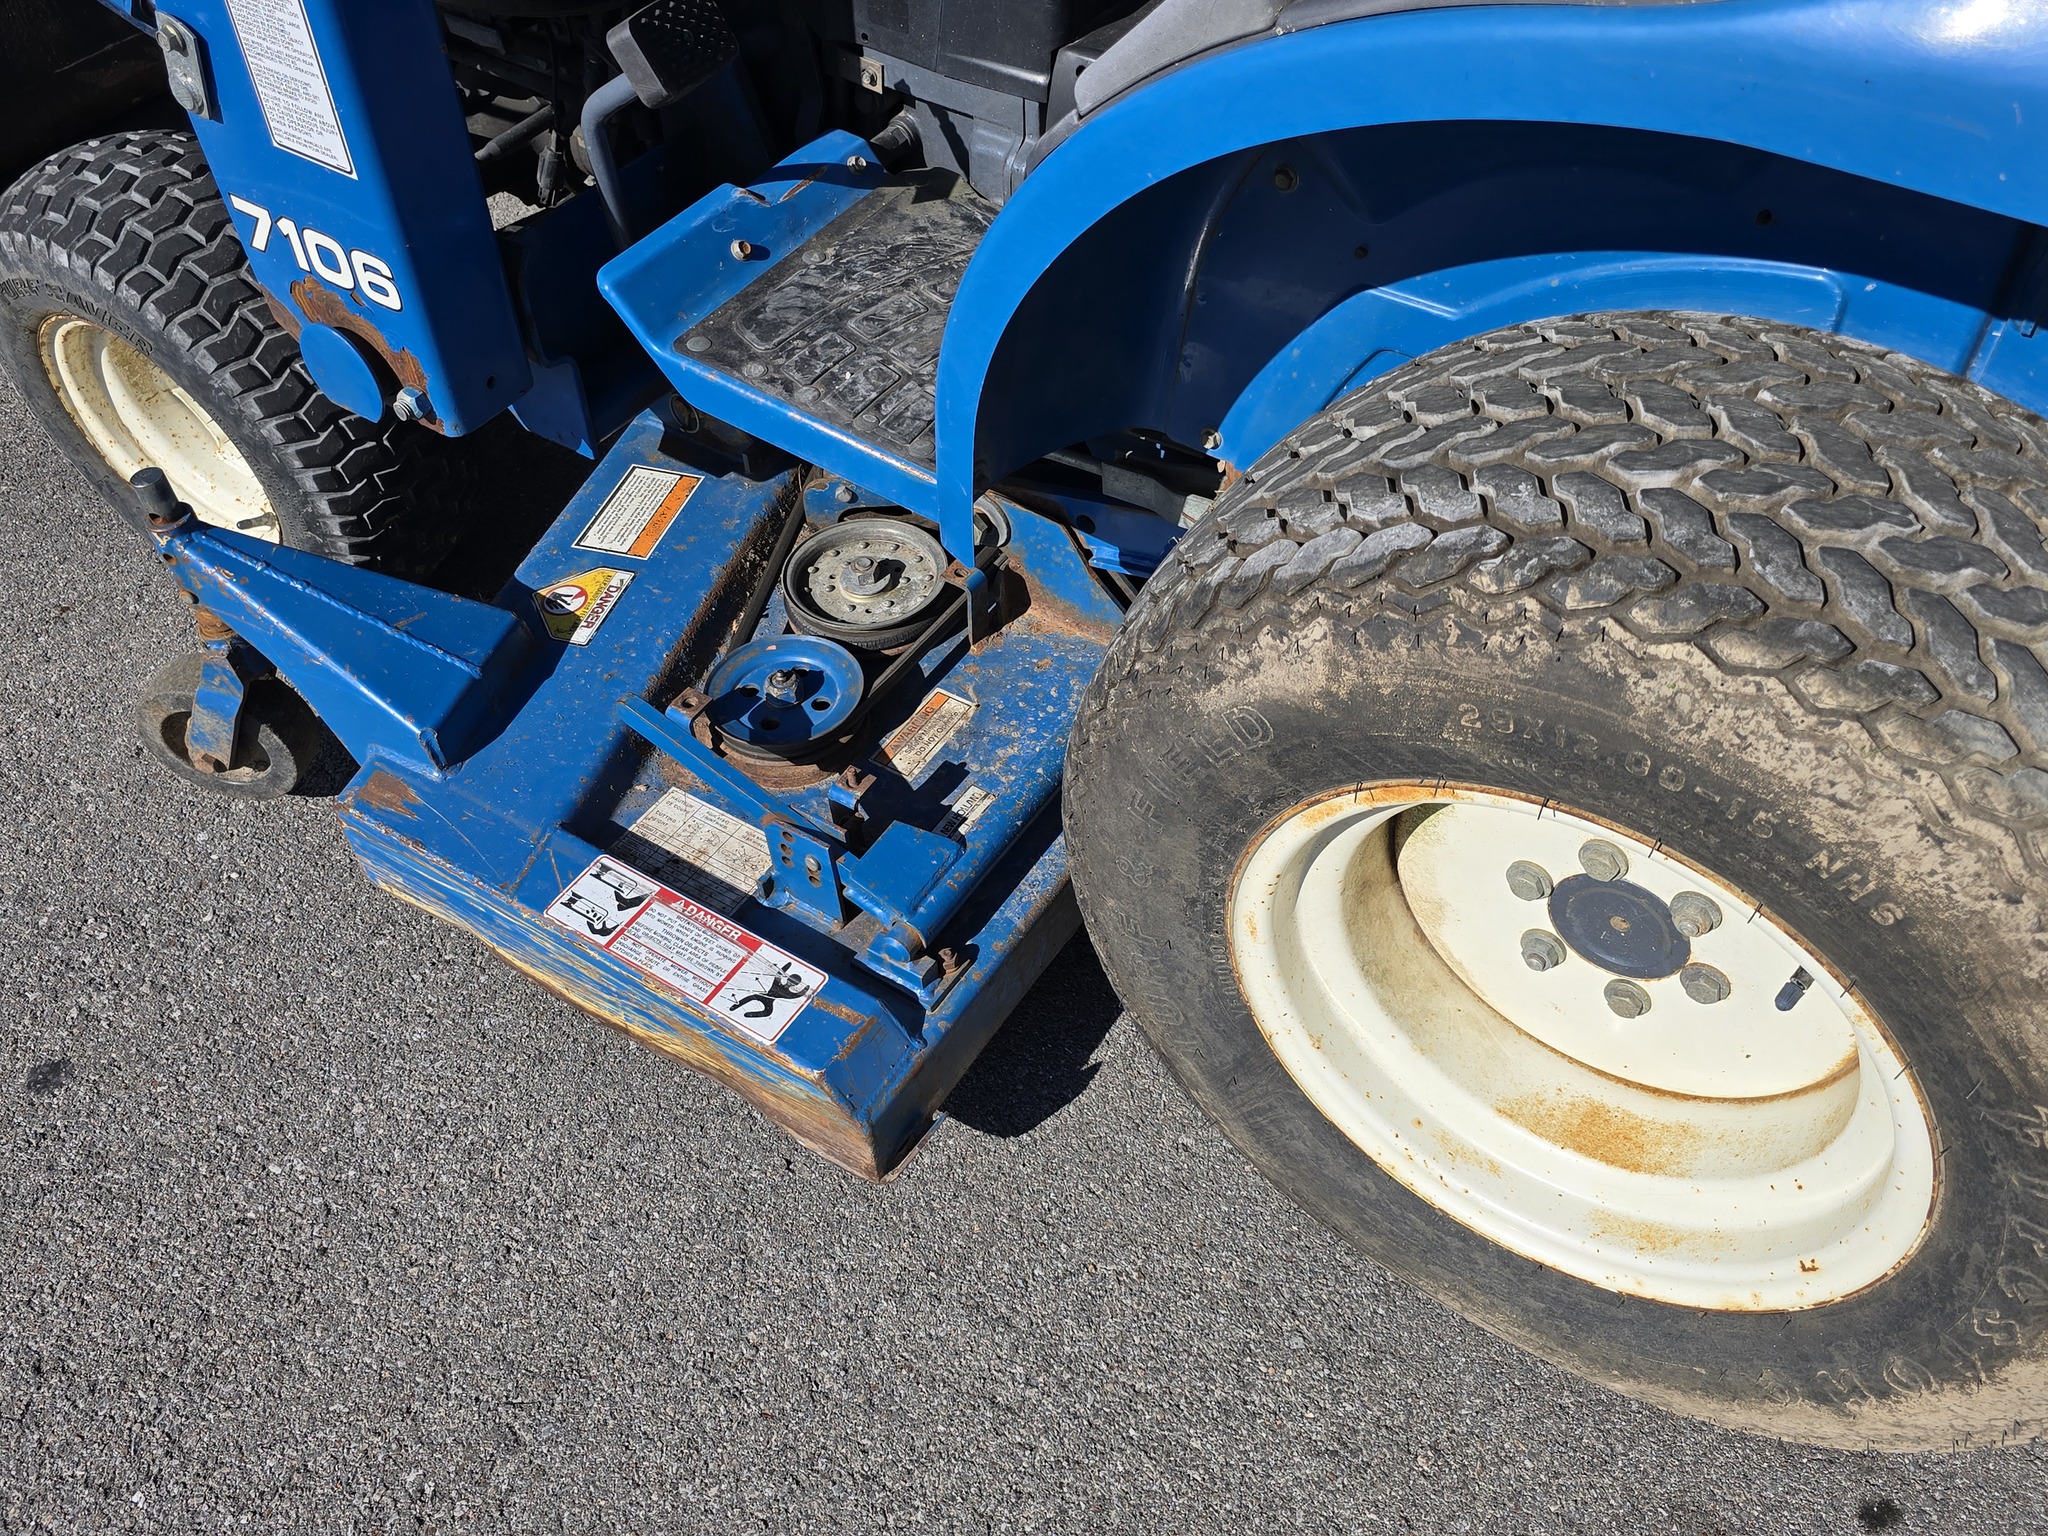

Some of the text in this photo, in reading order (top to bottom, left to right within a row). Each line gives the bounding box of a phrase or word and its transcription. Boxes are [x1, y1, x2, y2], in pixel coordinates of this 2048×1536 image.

[228, 192, 403, 313] 7106
[579, 584, 621, 629] DANGER
[894, 705, 935, 745] WARNING
[914, 746, 927, 757] DO
[923, 733, 939, 747] NOT
[1127, 705, 1276, 834] FIELD
[1805, 849, 1906, 926] NHS
[634, 920, 653, 932] BEFORE
[672, 941, 689, 952] CLEAR
[687, 950, 702, 959] AREA
[644, 911, 656, 919] INTO
[656, 917, 674, 929] MOWER
[674, 928, 689, 938] WHEN
[689, 936, 707, 948] ENGINE
[714, 949, 737, 964] RUNNING
[656, 911, 667, 919] NOT
[677, 922, 694, 933] HANDS
[702, 936, 715, 945] FEET
[714, 943, 732, 955] UNDER
[660, 927, 709, 957] THROWN OBJECTS
[674, 914, 720, 941] ROTATING BLADE
[683, 904, 743, 941] DANGER
[611, 943, 634, 958] CATCHER
[616, 939, 642, 956] DISCHARGE
[643, 955, 660, 966] CHUTE
[672, 971, 689, 983] ENTIRE
[691, 982, 708, 994] GRASS
[630, 924, 641, 932] AND
[640, 930, 662, 944] OBJECTS
[662, 942, 675, 951] THAT
[674, 949, 686, 957] MAY
[693, 960, 715, 974] THROWN
[630, 941, 642, 949] NOT
[644, 948, 667, 963] OPERATE
[669, 962, 689, 975] MOWER
[690, 975, 713, 989] WITHOUT
